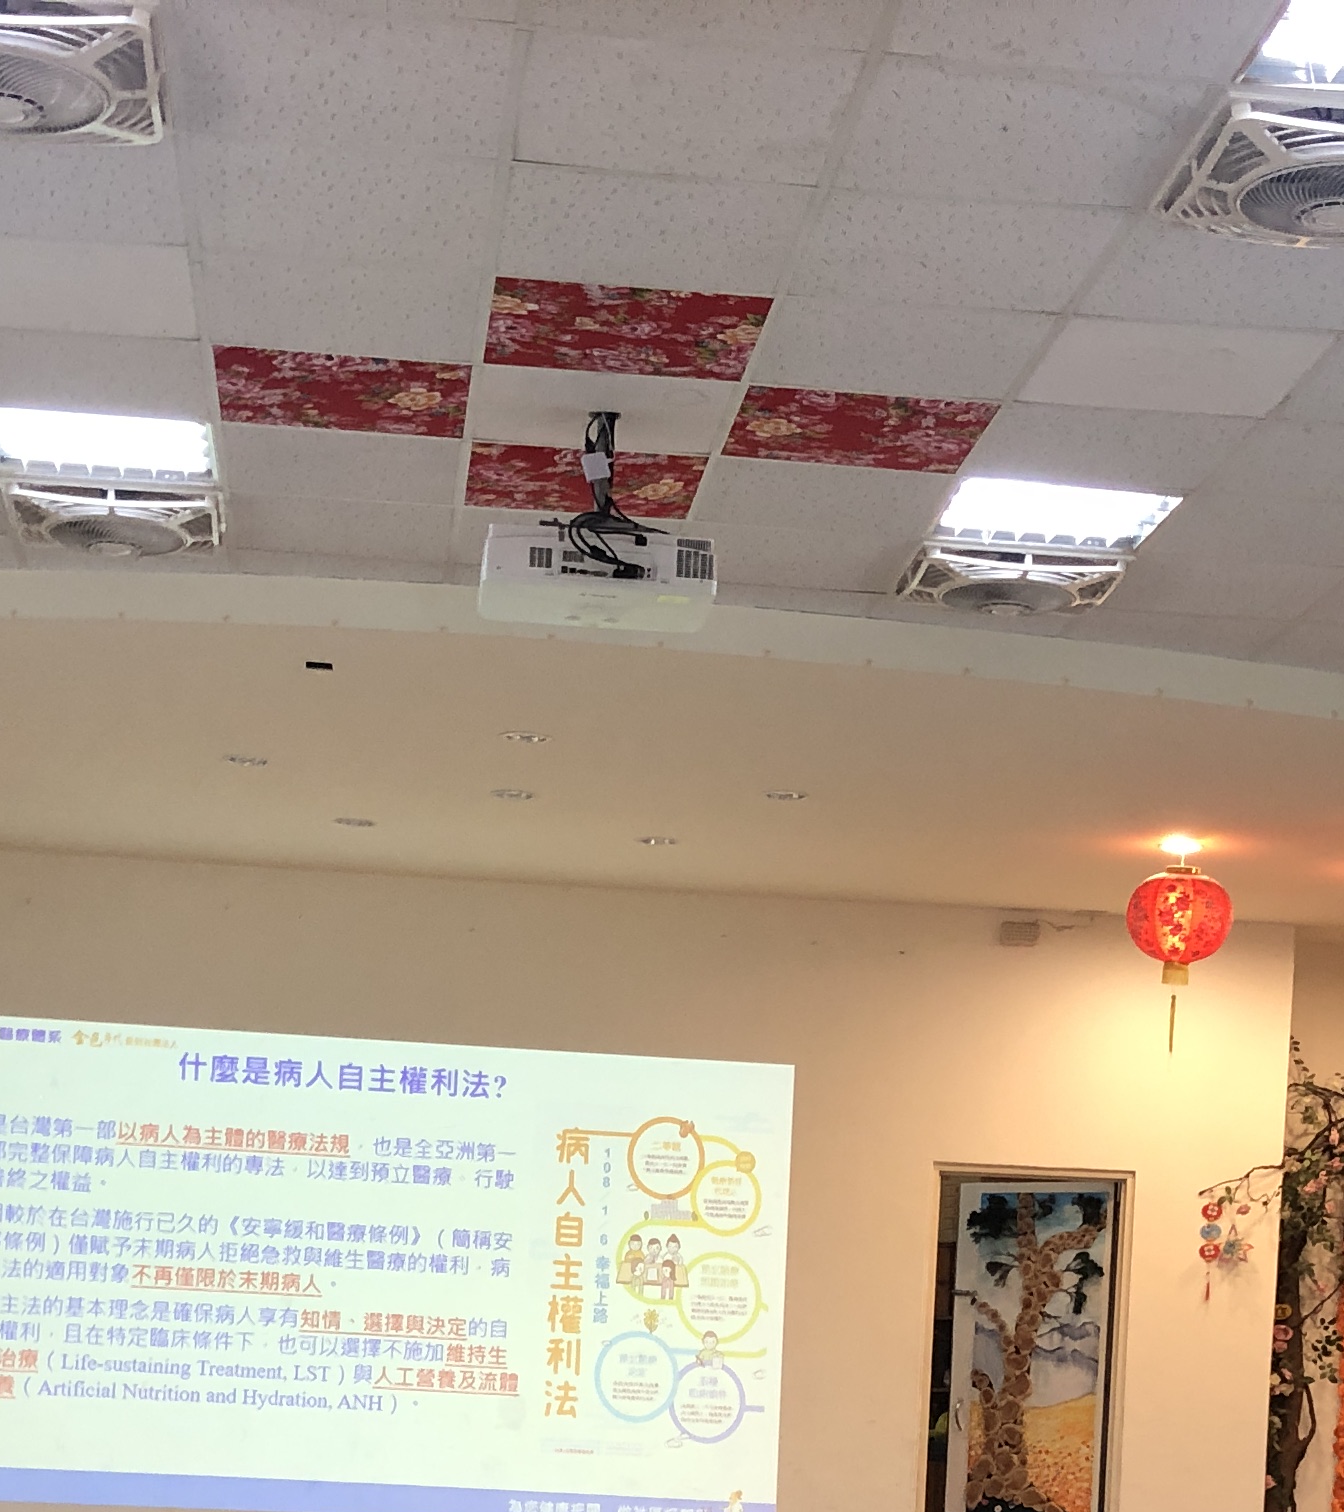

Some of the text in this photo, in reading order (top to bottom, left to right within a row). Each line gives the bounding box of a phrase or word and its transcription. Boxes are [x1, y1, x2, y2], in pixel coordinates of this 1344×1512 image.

[178, 1051, 507, 1099] 什麼是病人自主權利法?
[544, 1127, 590, 1419] 病人自主權利法
[122, 1382, 201, 1402] Nutrition
[206, 1385, 237, 1405] and
